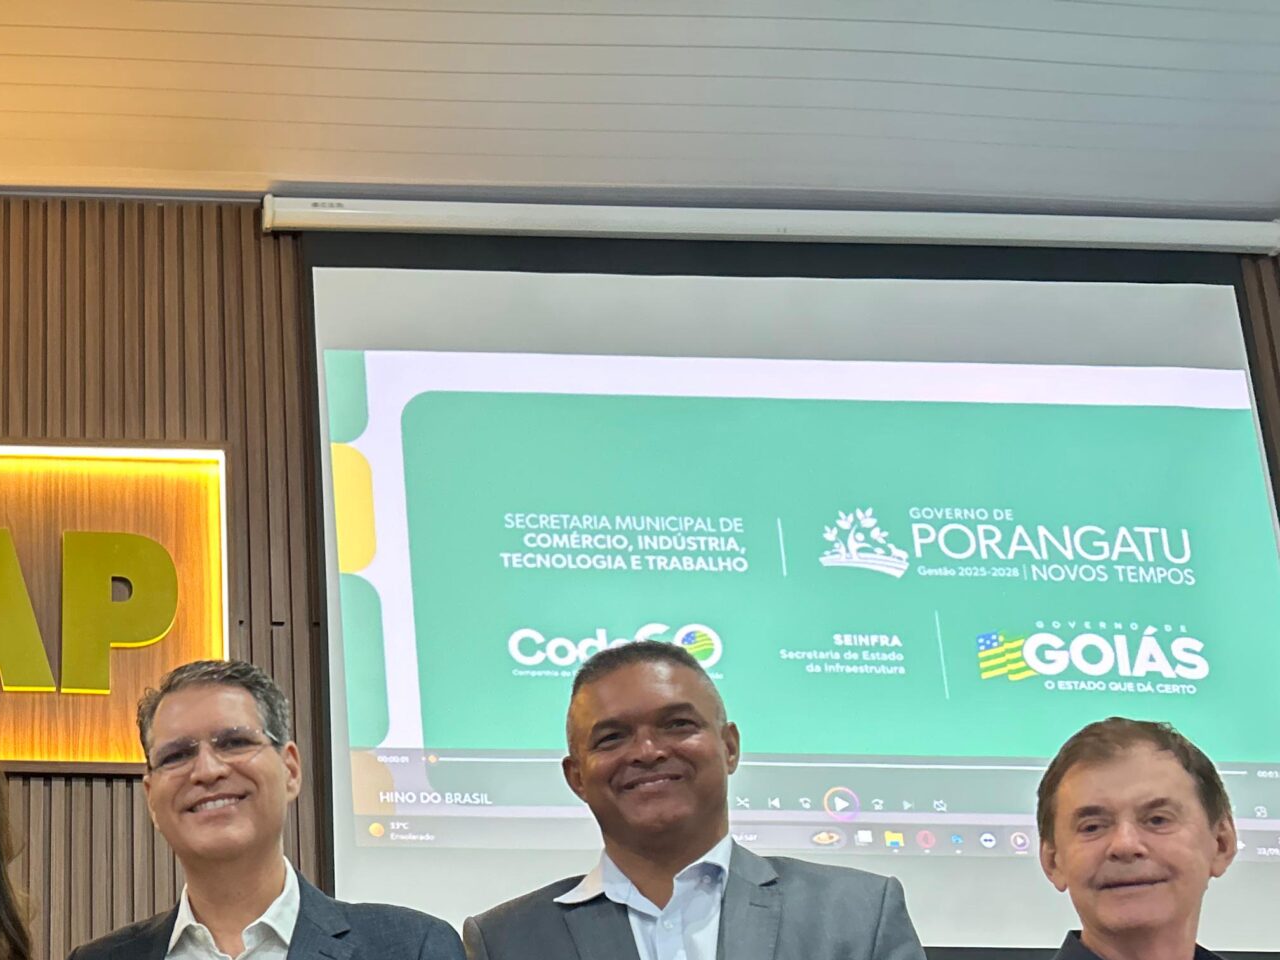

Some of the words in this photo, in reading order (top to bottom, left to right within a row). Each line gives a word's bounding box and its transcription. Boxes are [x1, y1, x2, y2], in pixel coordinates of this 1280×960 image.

[909, 507, 988, 520] GOVERNO
[993, 508, 1014, 521] DE
[504, 513, 611, 530] SECRETARIA
[615, 514, 716, 532] MUNICIPAL
[719, 517, 744, 532] DE
[523, 531, 633, 552] COMÉRCIO,
[637, 533, 746, 554] INDÚSTRIA,
[912, 523, 1192, 564] PORANGATU
[500, 552, 627, 570] TECNOLOGIA
[631, 555, 642, 569] E
[645, 555, 749, 572] TRABALHO
[917, 565, 956, 577] Gestão
[958, 566, 1020, 577] 2025-2028
[1031, 564, 1108, 582] NOVOS
[1114, 566, 1196, 586] TEMPOS
[1035, 620, 1139, 631] GOVERNO
[1163, 624, 1187, 633] DE
[832, 634, 903, 647] SEINFRA
[779, 649, 841, 660] Secretaria
[843, 650, 859, 660] de
[862, 650, 904, 661] Estado
[1023, 625, 1209, 680] GOIÁS
[805, 662, 821, 673] da
[824, 663, 906, 674] Infraestrutura
[1044, 680, 1055, 690] O
[1057, 680, 1107, 691] ESTADO
[1108, 681, 1135, 692] QUE
[1136, 681, 1155, 693] DÁ
[1156, 683, 1197, 694] CERTO
[379, 791, 417, 804] HINO
[420, 792, 442, 804] DO
[444, 792, 493, 805] BRASIL
